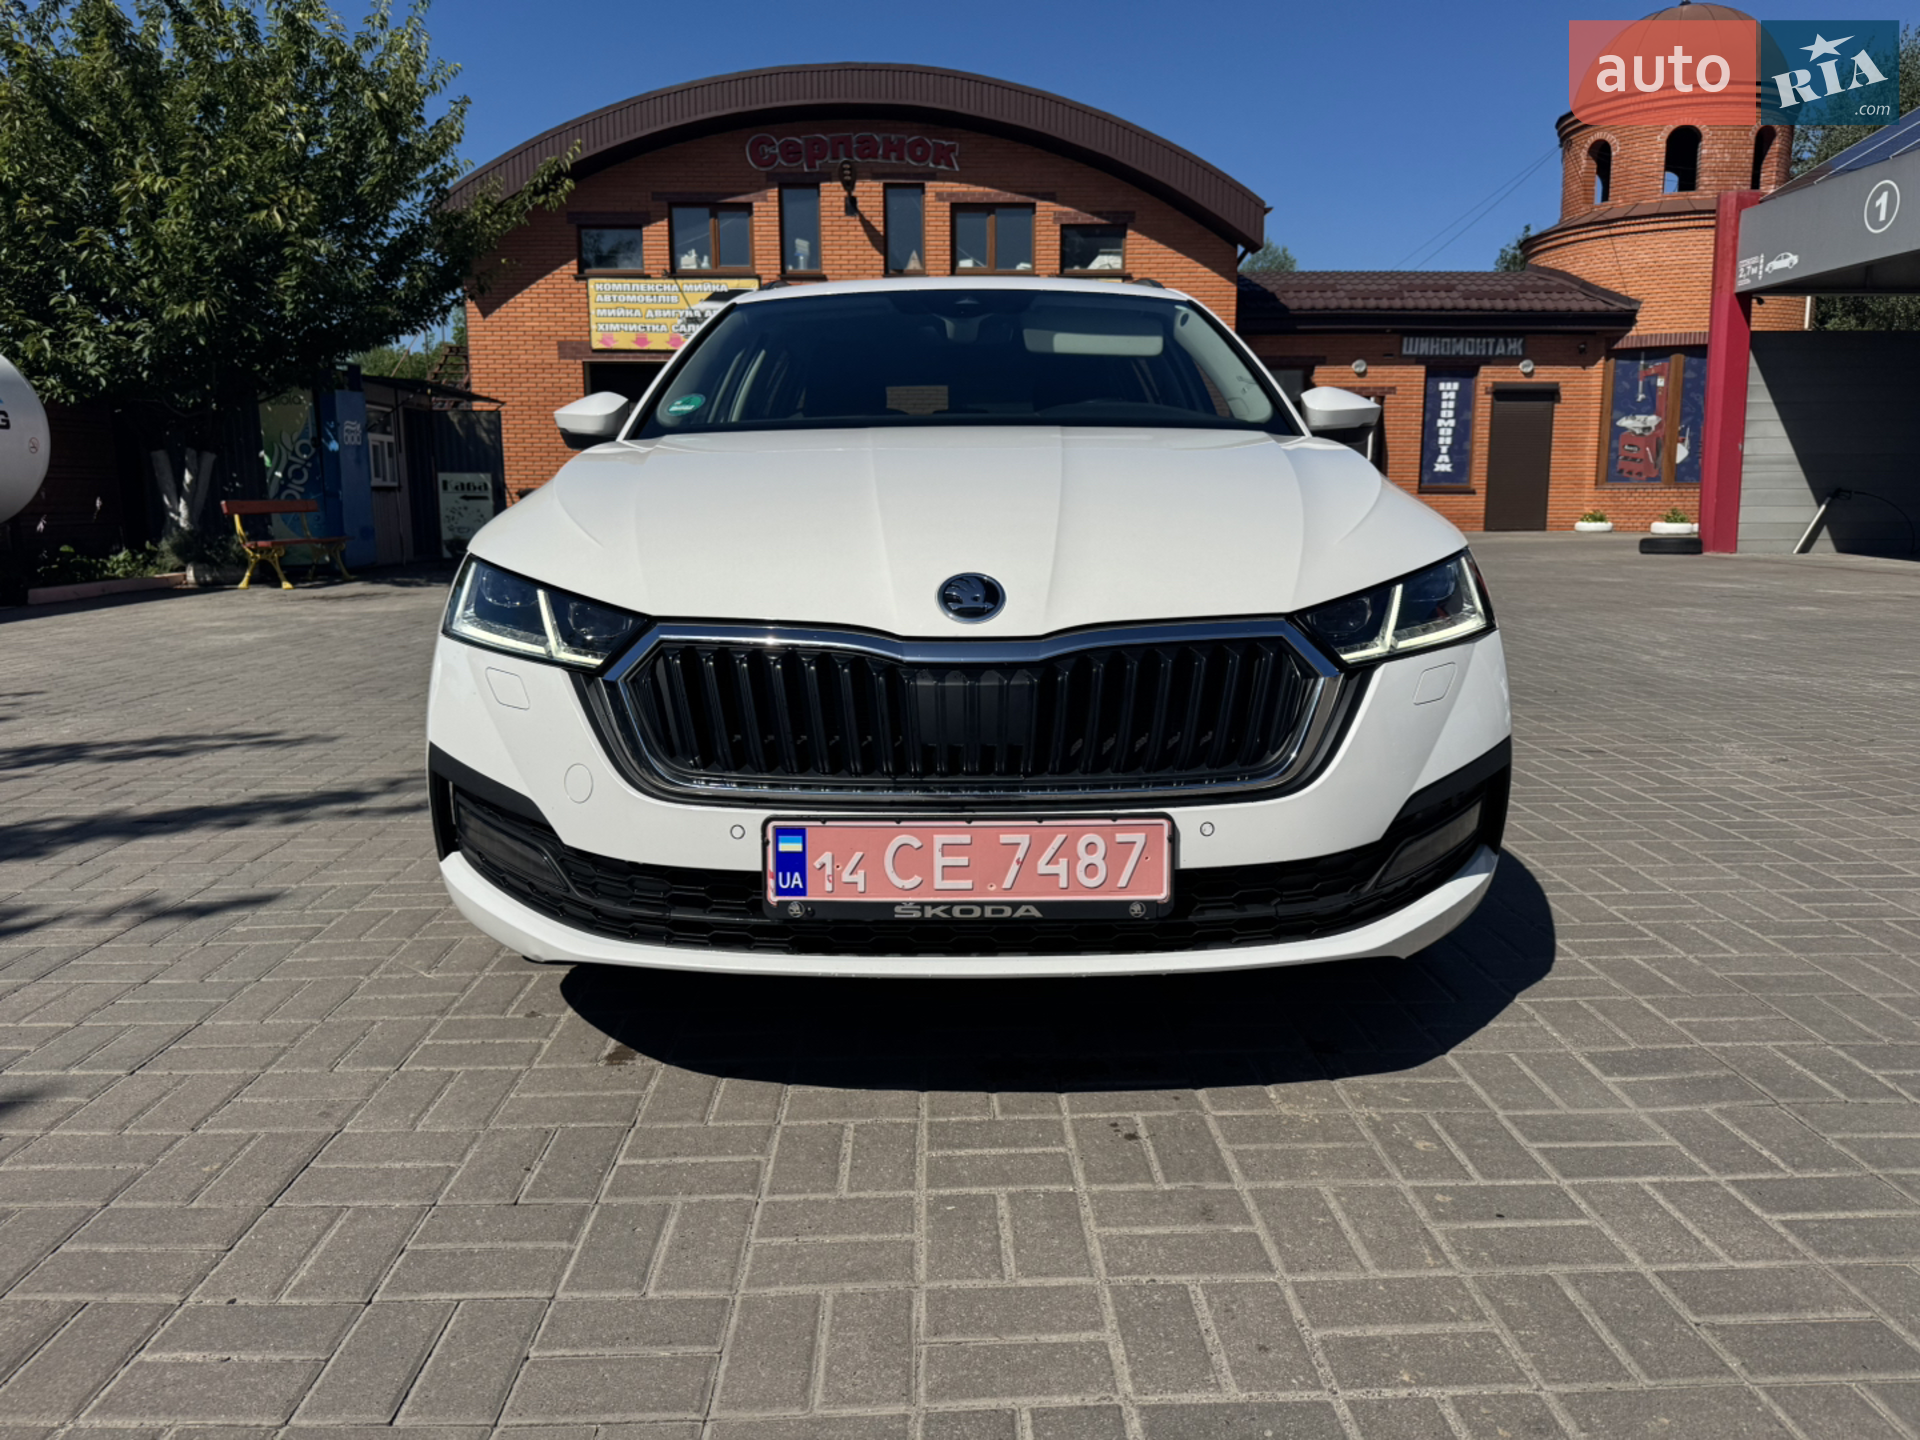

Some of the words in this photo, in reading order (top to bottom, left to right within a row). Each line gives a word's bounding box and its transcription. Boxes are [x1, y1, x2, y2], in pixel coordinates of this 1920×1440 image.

[746, 132, 959, 172] Серпанок
[1875, 191, 1889, 222] 1
[595, 282, 681, 293] КОМПЛЕКСНА
[682, 282, 728, 293] МИЙКА
[595, 294, 679, 304] АВТОМОБІЛІВ
[596, 308, 642, 318] МИЙКА
[597, 323, 668, 333] ХІМЧИСТКА
[1402, 337, 1524, 356] ШИНОМОНТАЖ
[1433, 382, 1459, 472] ШИНОМОНТАЖ
[813, 851, 866, 893] 14
[883, 834, 974, 890] CE
[999, 833, 1147, 889] 7487
[778, 871, 804, 889] UA
[894, 902, 1043, 919] ŠKODA
